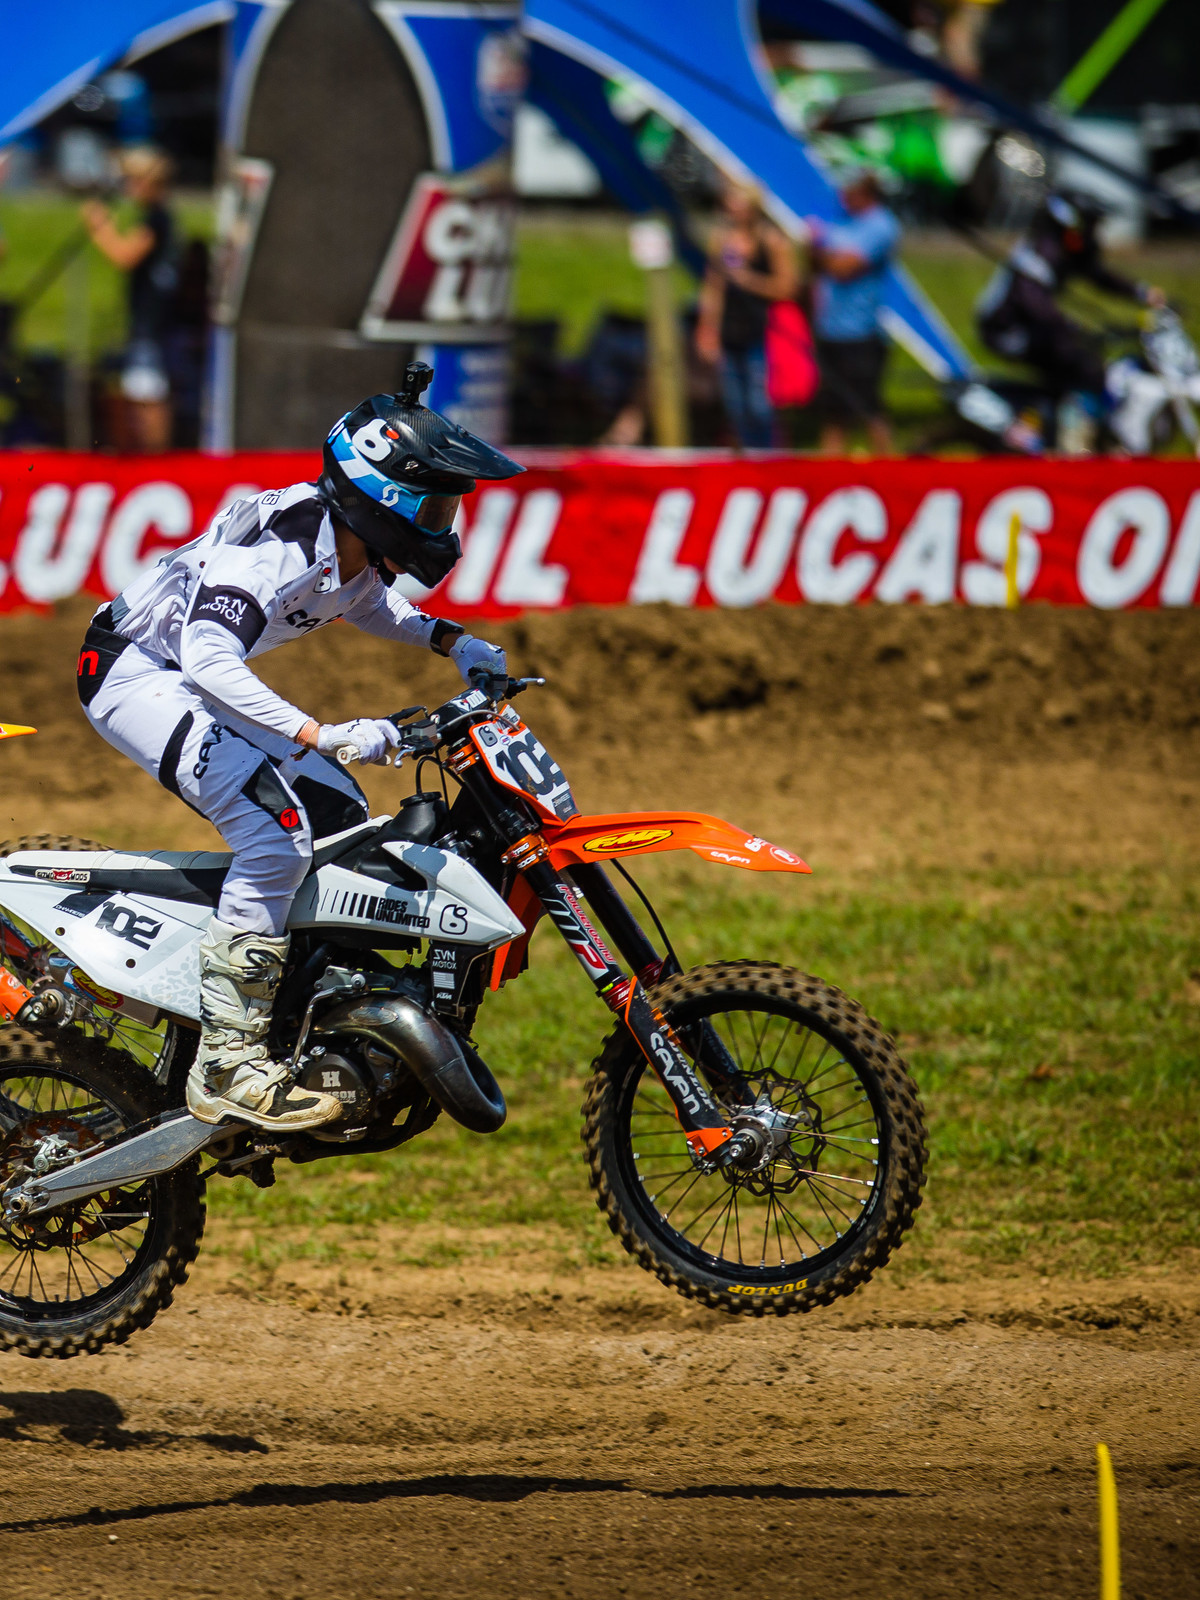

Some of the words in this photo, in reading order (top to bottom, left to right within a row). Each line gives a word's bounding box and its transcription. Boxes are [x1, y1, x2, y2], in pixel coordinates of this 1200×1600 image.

[629, 486, 1054, 606] LUCAS
[1076, 486, 1200, 609] OI
[198, 602, 243, 626] MOTOX
[495, 732, 571, 799] 102
[584, 829, 673, 851] FMF
[377, 897, 408, 913] RIDES
[95, 901, 166, 951] 102
[375, 909, 430, 929] UNLIMITED
[432, 960, 457, 970] MOTOX
[321, 1071, 341, 1088] H
[667, 1039, 715, 1111] DUNLOP
[727, 1278, 809, 1297] DUNLOP
